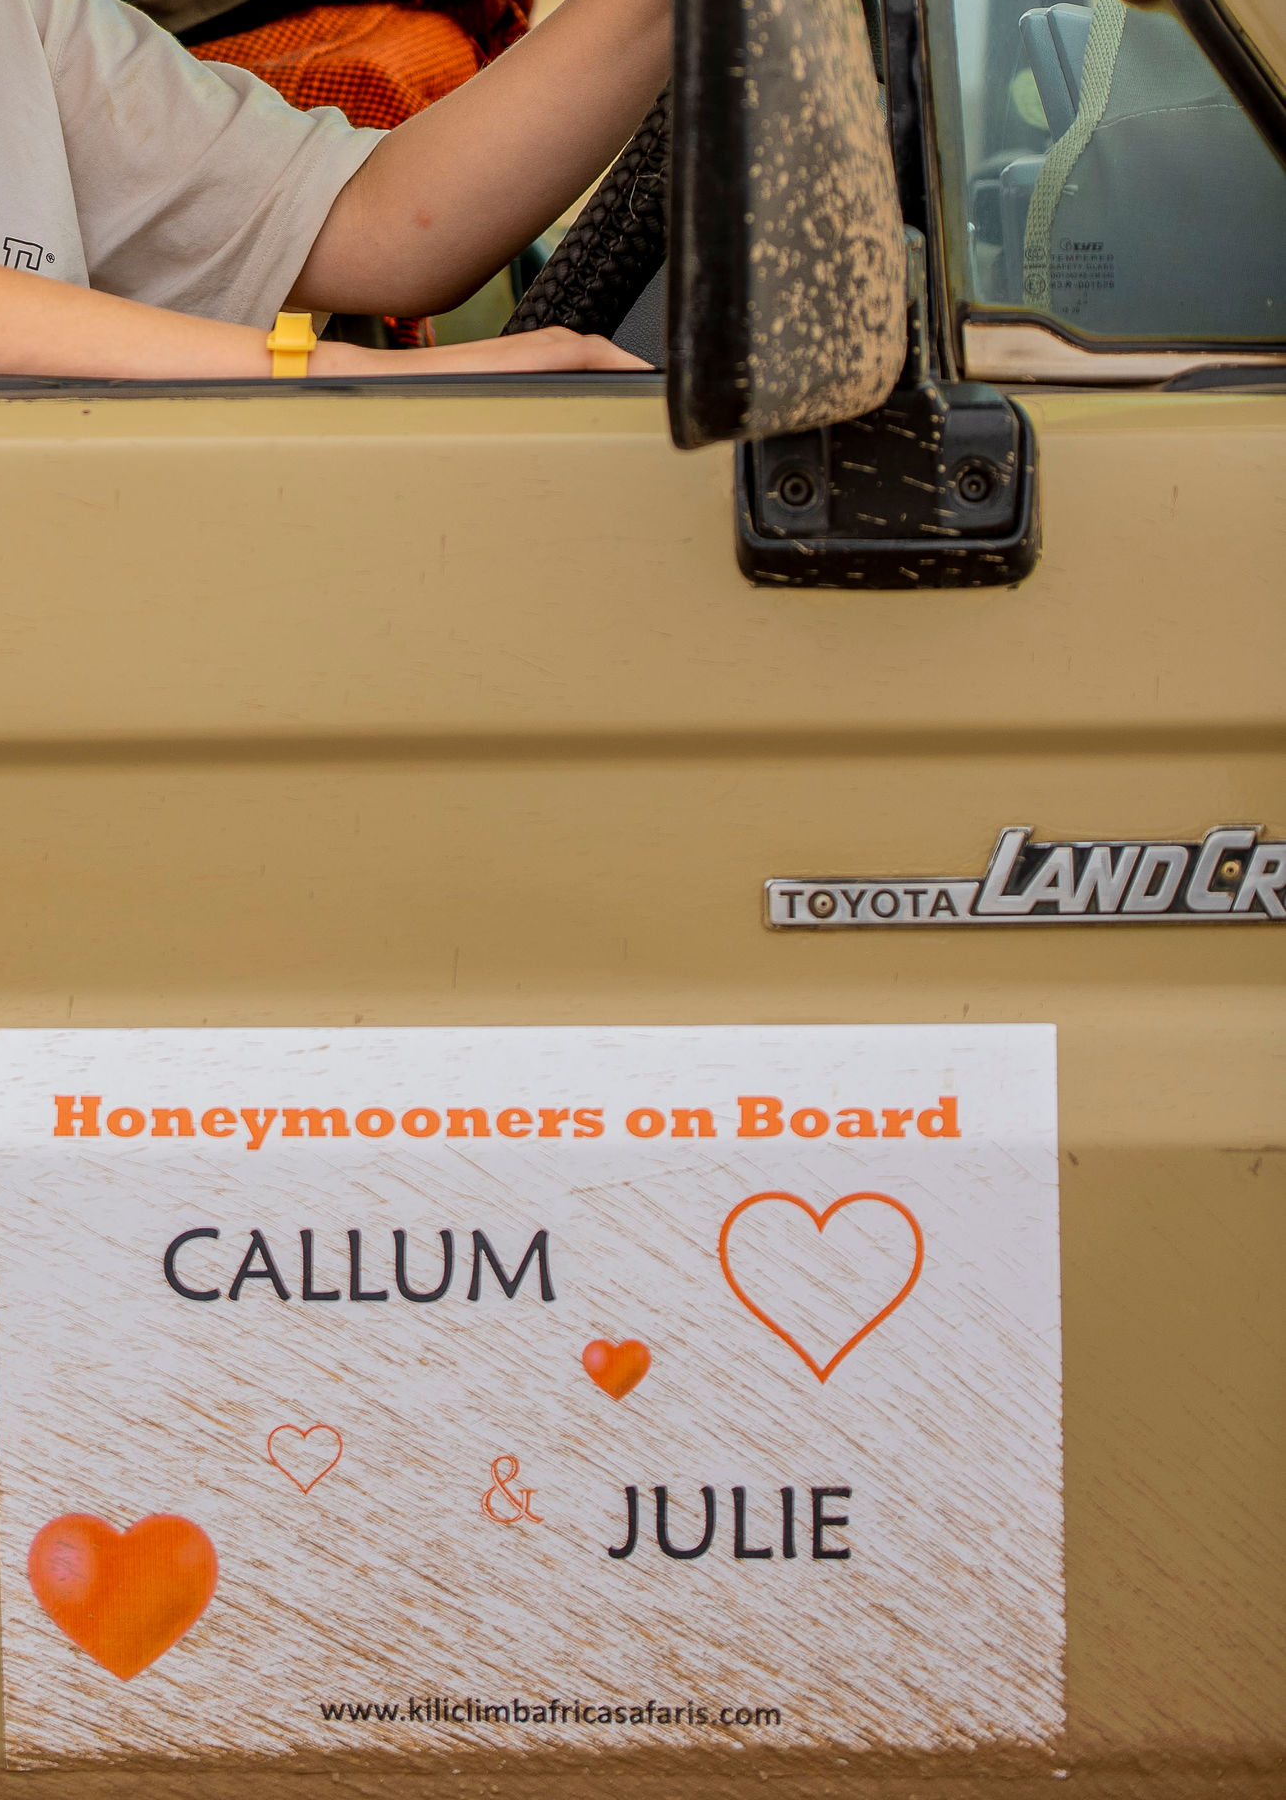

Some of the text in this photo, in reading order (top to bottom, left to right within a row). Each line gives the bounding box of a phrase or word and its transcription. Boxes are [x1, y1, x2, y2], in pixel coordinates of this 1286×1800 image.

[779, 887, 959, 919] TOYOTA
[53, 1095, 962, 1151] Honeymooners on Board
[162, 1226, 556, 1303] CALLUM
[480, 1455, 855, 1561] & JULIE
[319, 1697, 782, 1726] www.kiliclimbafricasafaris.com
